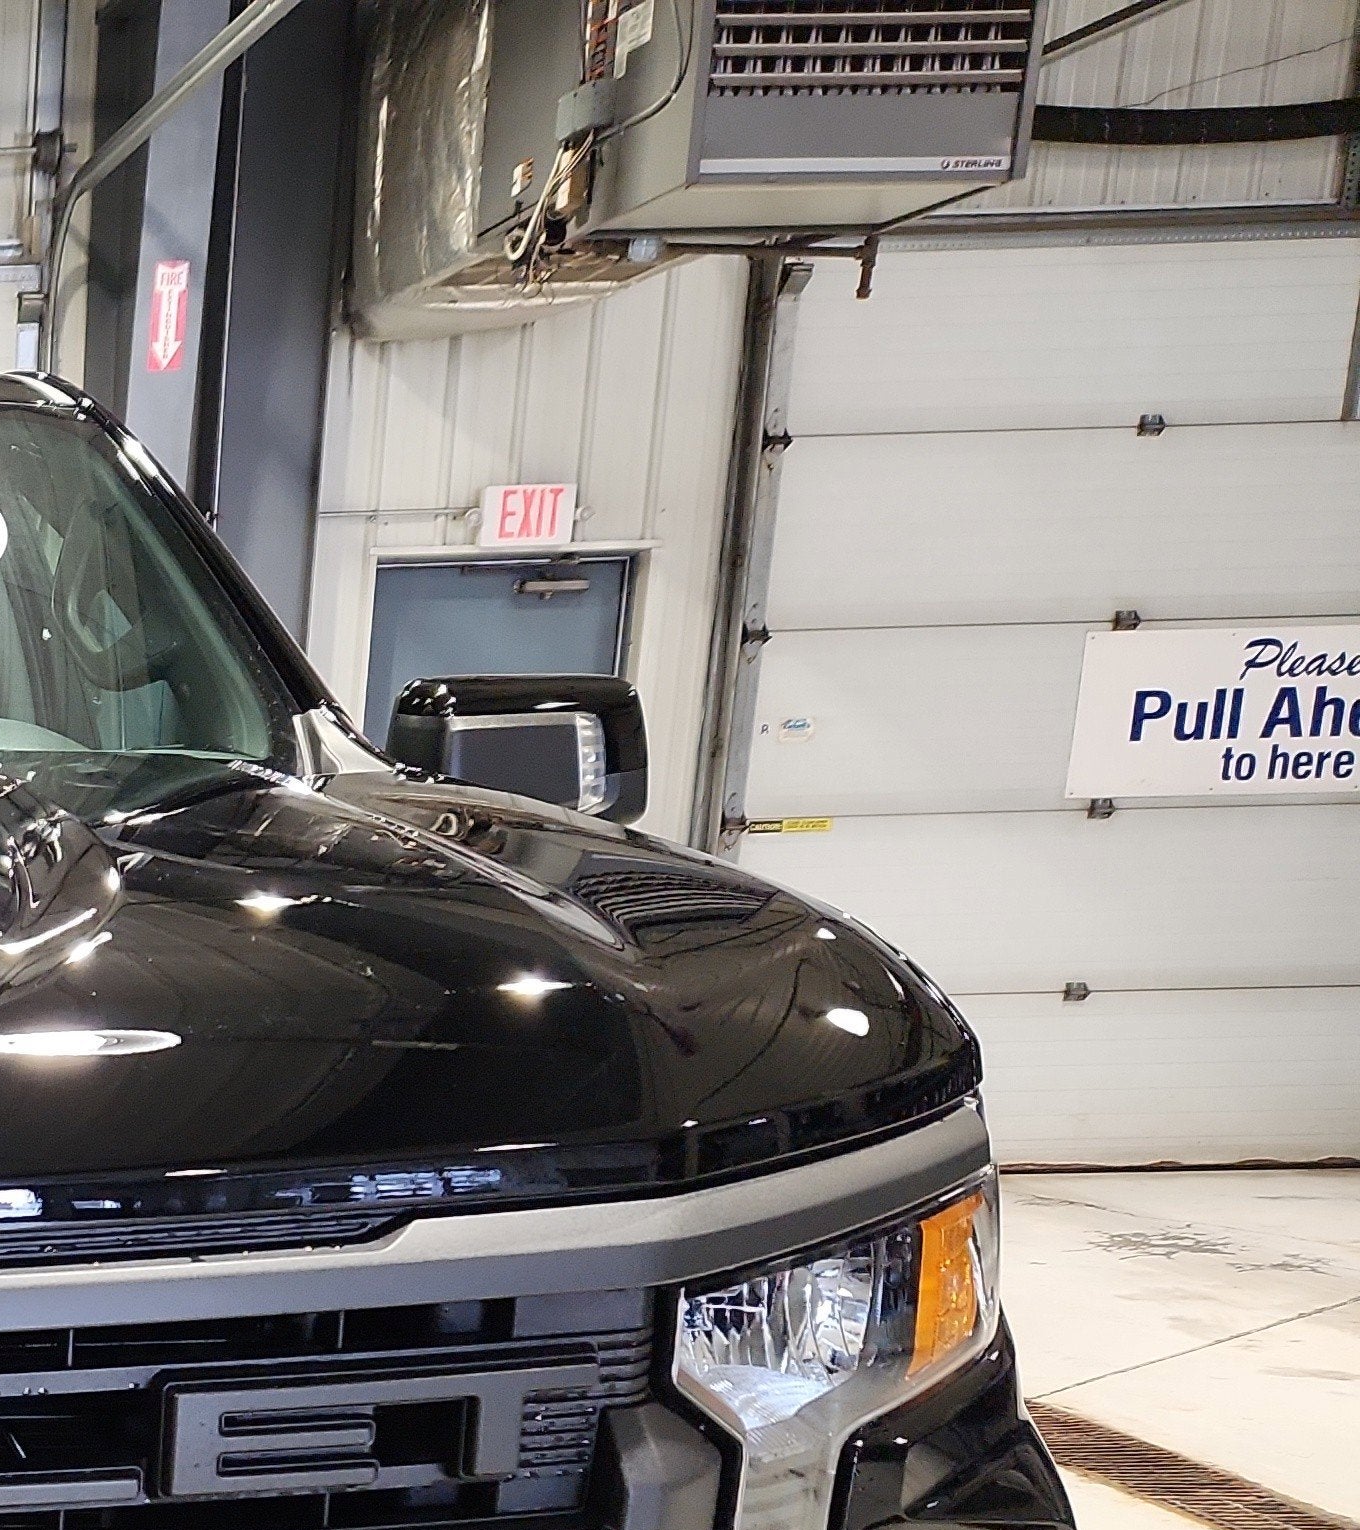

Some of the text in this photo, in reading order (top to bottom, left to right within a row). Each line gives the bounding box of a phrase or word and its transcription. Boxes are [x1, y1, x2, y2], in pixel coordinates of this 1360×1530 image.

[161, 272, 183, 286] FIRE
[498, 487, 564, 539] EXIT
[1239, 637, 1360, 681] Please
[1129, 687, 1244, 742] Pull
[1221, 743, 1355, 781] to here
